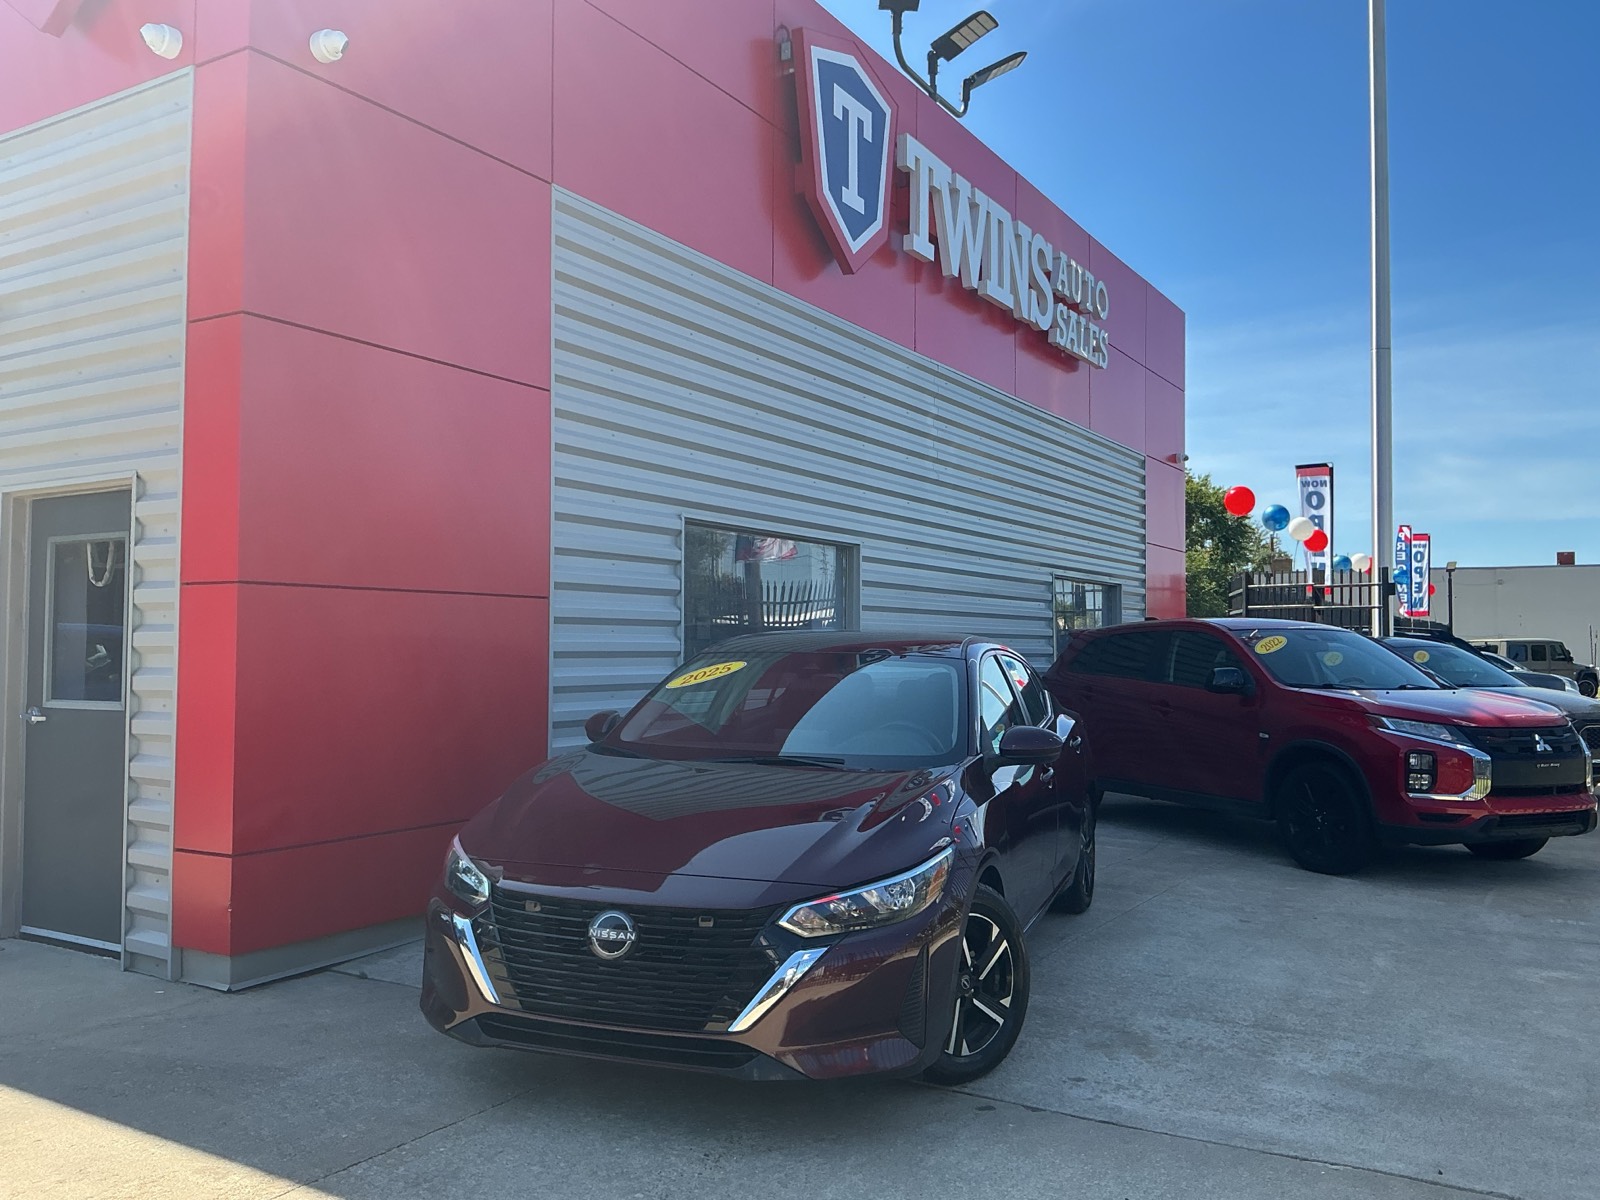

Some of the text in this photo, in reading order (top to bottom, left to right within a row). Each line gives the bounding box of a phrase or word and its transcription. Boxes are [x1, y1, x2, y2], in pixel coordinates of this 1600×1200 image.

[833, 83, 873, 215] T
[898, 132, 1054, 331] TWINS
[1055, 251, 1109, 320] AUTO
[1055, 302, 1109, 369] SALES
[680, 663, 733, 685] 2025
[589, 928, 636, 941] NISSAN
